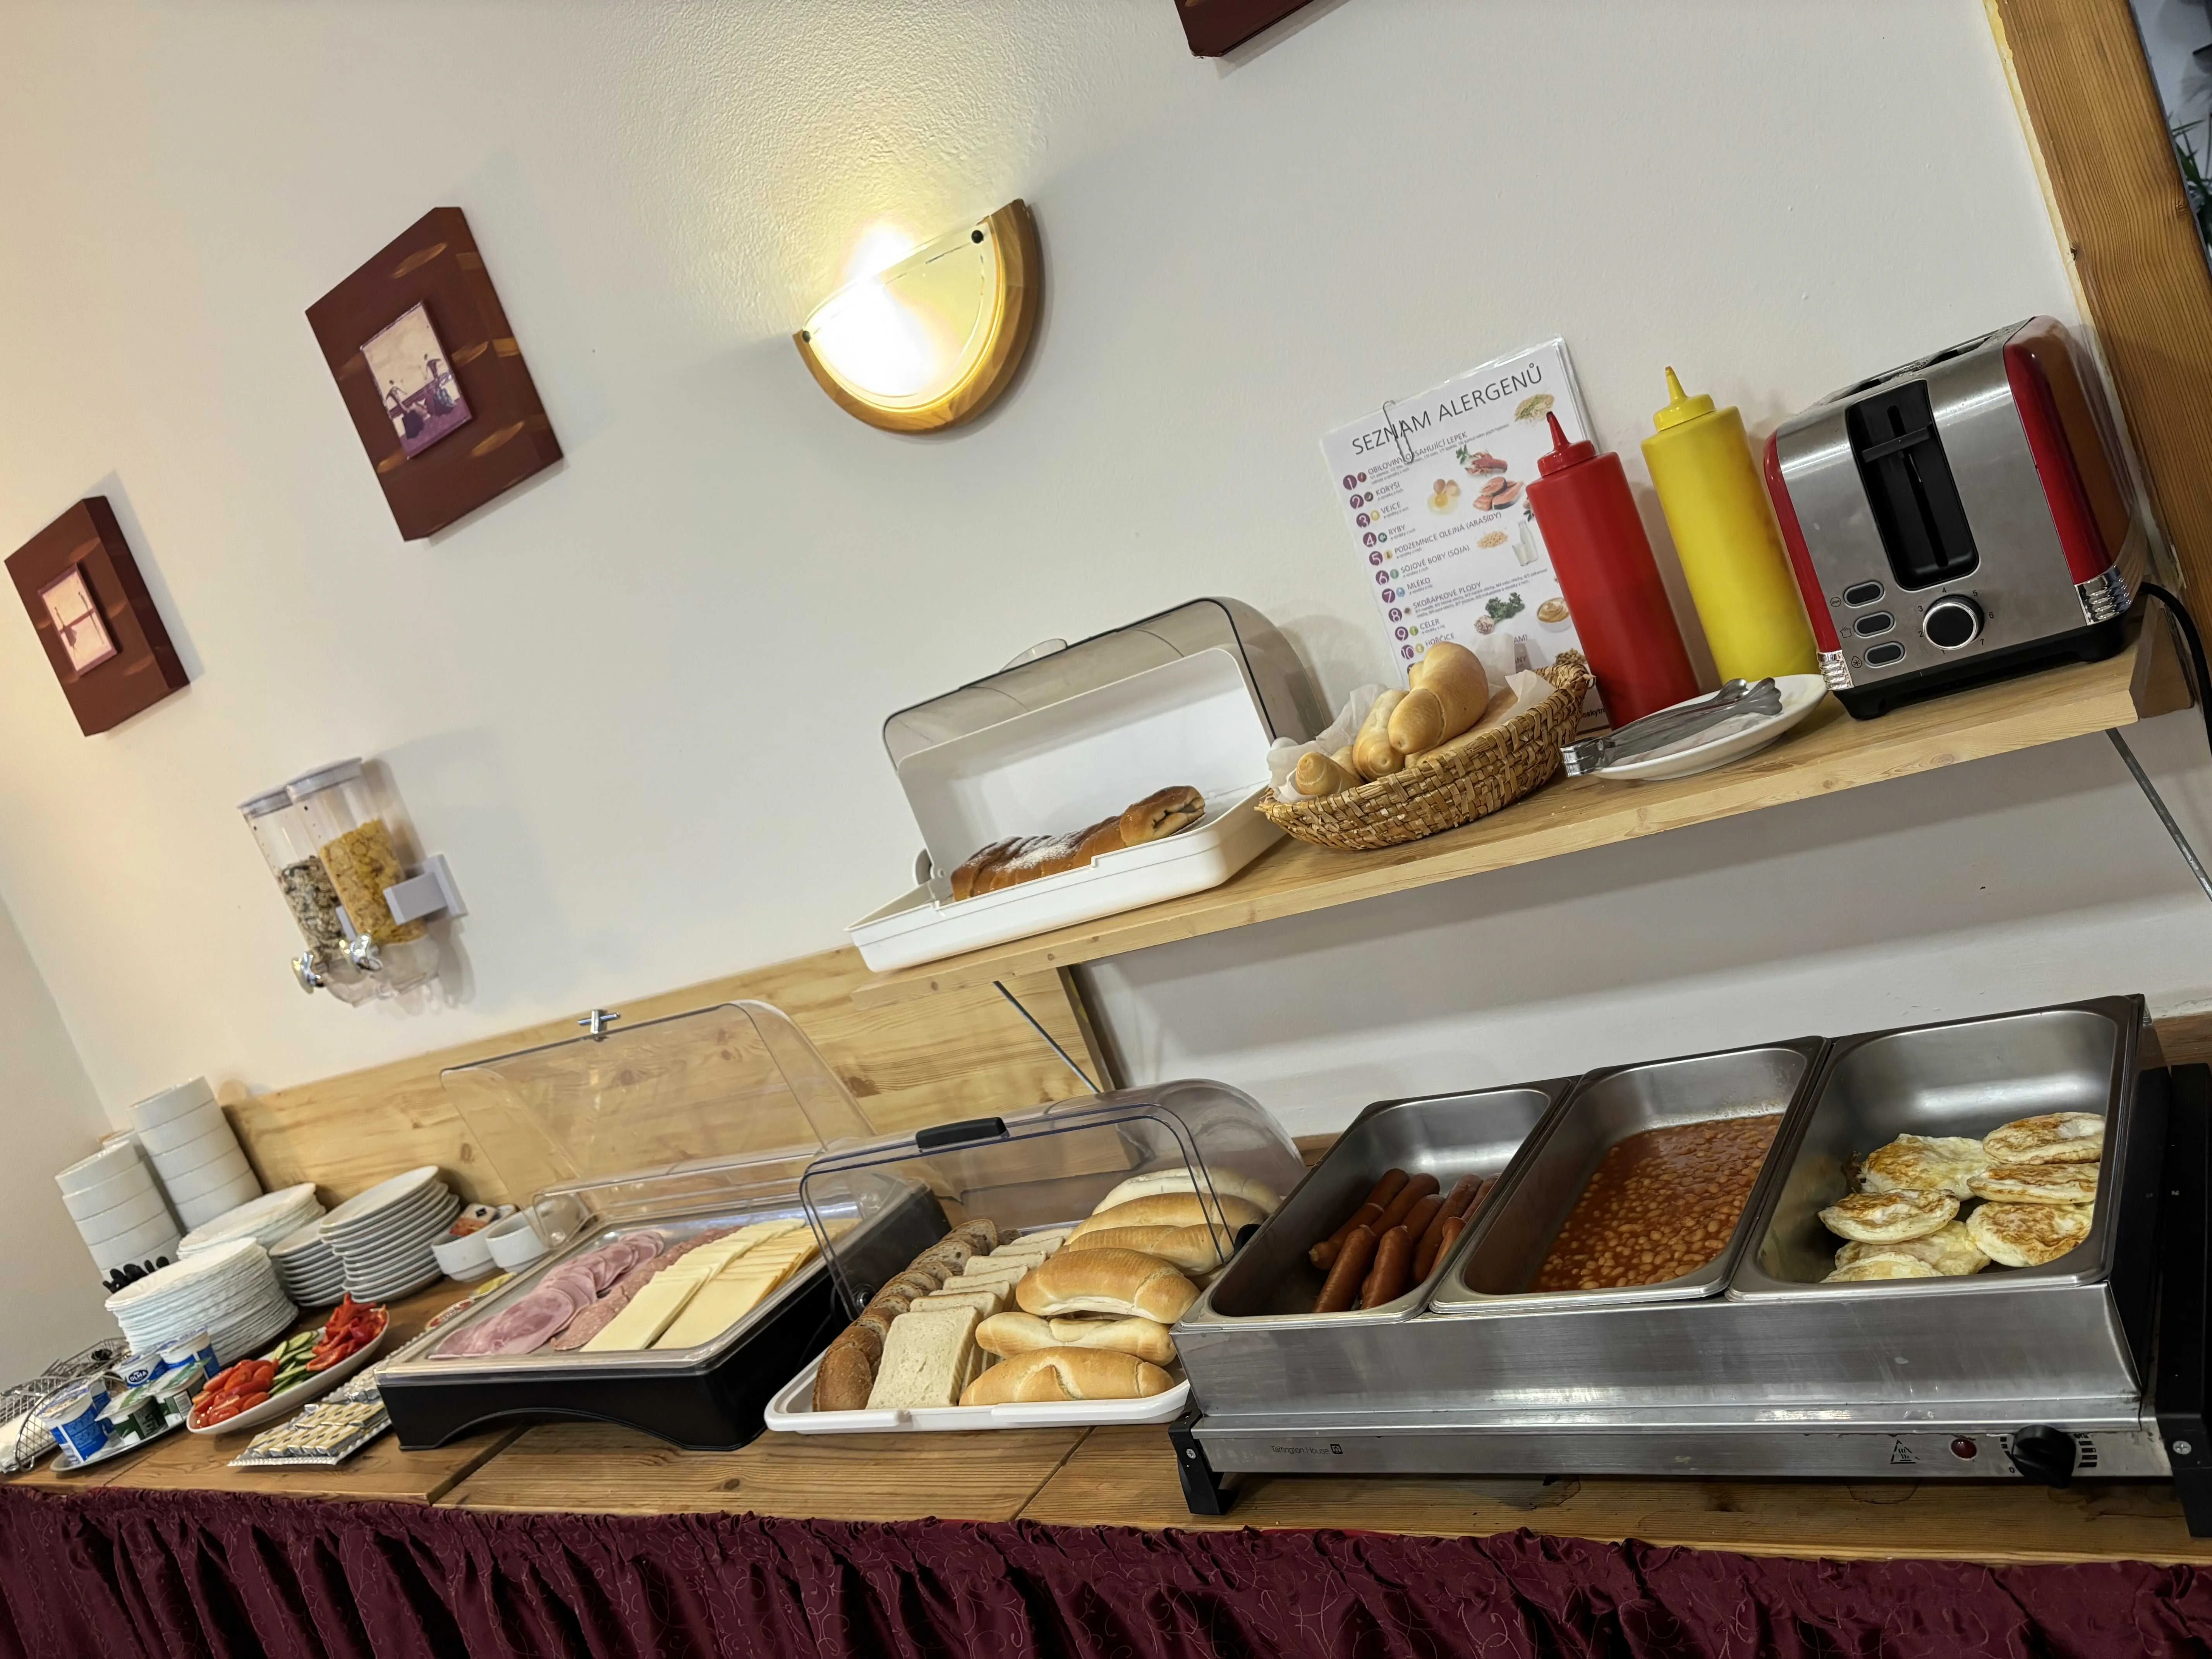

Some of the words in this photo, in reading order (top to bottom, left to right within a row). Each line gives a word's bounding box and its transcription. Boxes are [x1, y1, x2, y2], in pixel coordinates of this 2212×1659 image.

[1352, 411, 1431, 455] SEZNAM
[1439, 363, 1542, 422] ALERGENŮ
[1368, 457, 1403, 474] OBILOVINY
[1447, 431, 1468, 444] LEPEK
[1352, 496, 1360, 509] 2
[1359, 515, 1368, 527] 3
[1381, 501, 1401, 514] VEJCE
[1366, 534, 1374, 546] 4
[1388, 524, 1405, 535] RYBY
[1372, 553, 1381, 565] 5
[1395, 534, 1437, 554] PODZEMNICE
[1439, 523, 1465, 538] OLEJNÁ
[1466, 511, 1501, 529] (ARAŠÍDY)
[1379, 572, 1387, 585] 6
[1427, 552, 1445, 564] BOBY
[1384, 591, 1391, 603] 7
[1391, 609, 1400, 622] 8
[1459, 581, 1481, 594] PLODY
[1397, 628, 1406, 641] 9
[1420, 618, 1440, 630] CELER
[129, 1371, 147, 1381] OLMA
